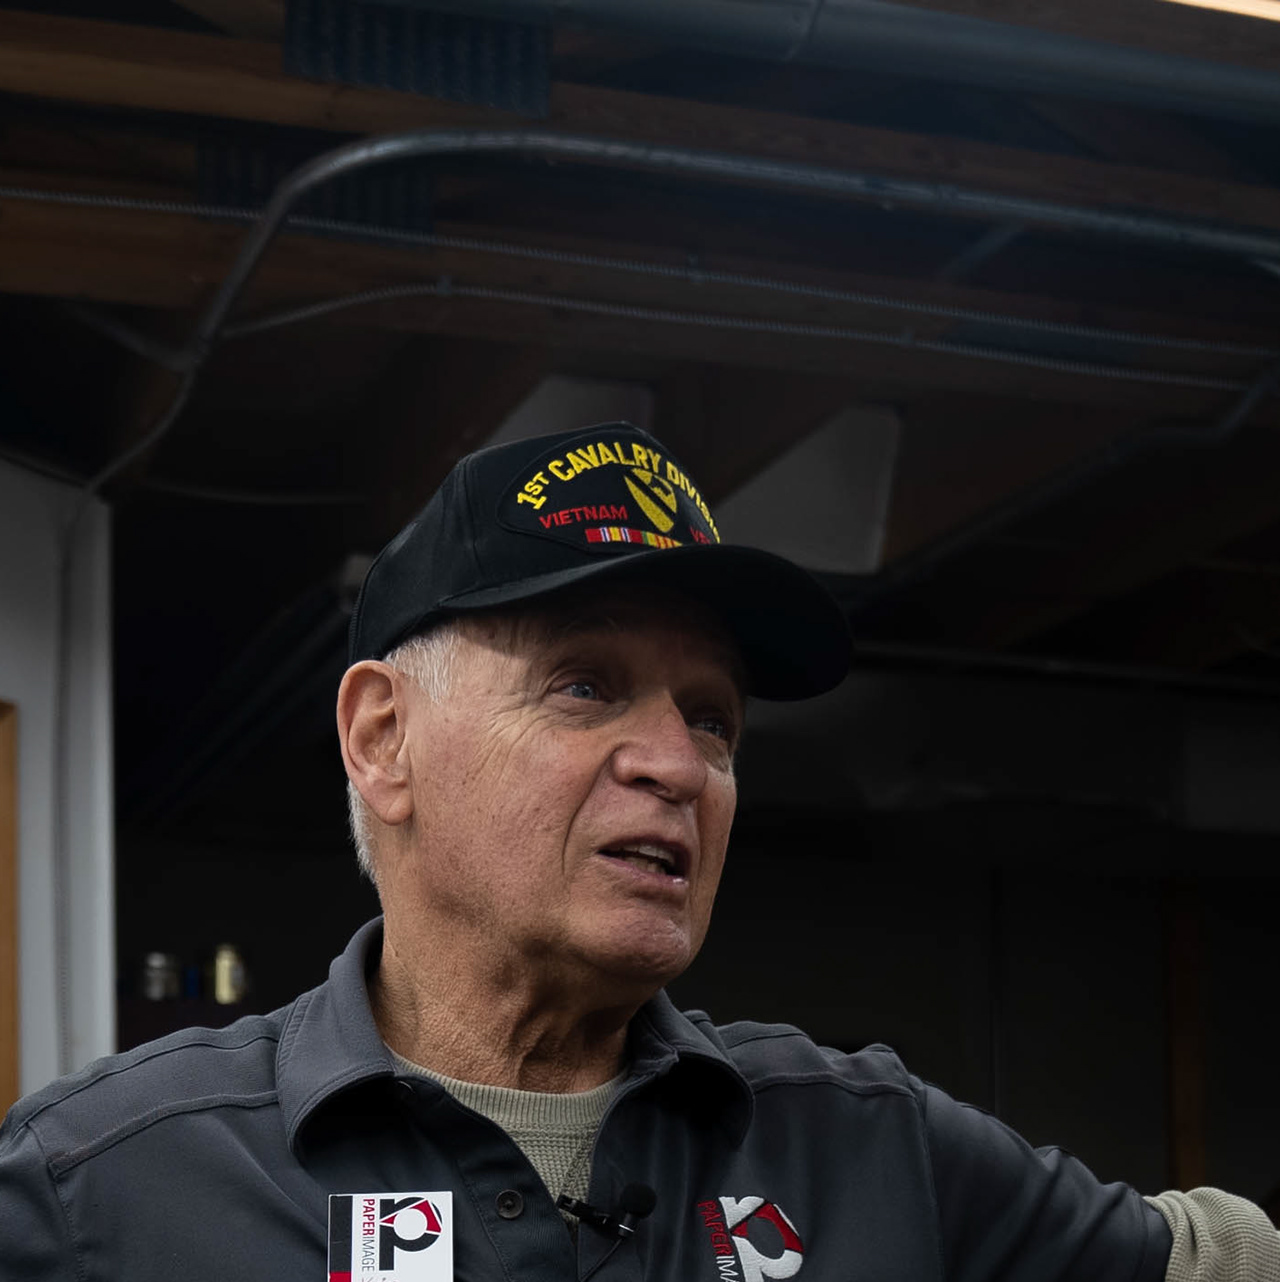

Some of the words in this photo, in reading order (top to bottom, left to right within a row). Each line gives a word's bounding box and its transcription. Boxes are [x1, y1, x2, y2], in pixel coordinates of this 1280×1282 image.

[517, 471, 548, 510] 1ST
[548, 441, 660, 482] CAVALRY
[539, 504, 628, 529] VIETNAM
